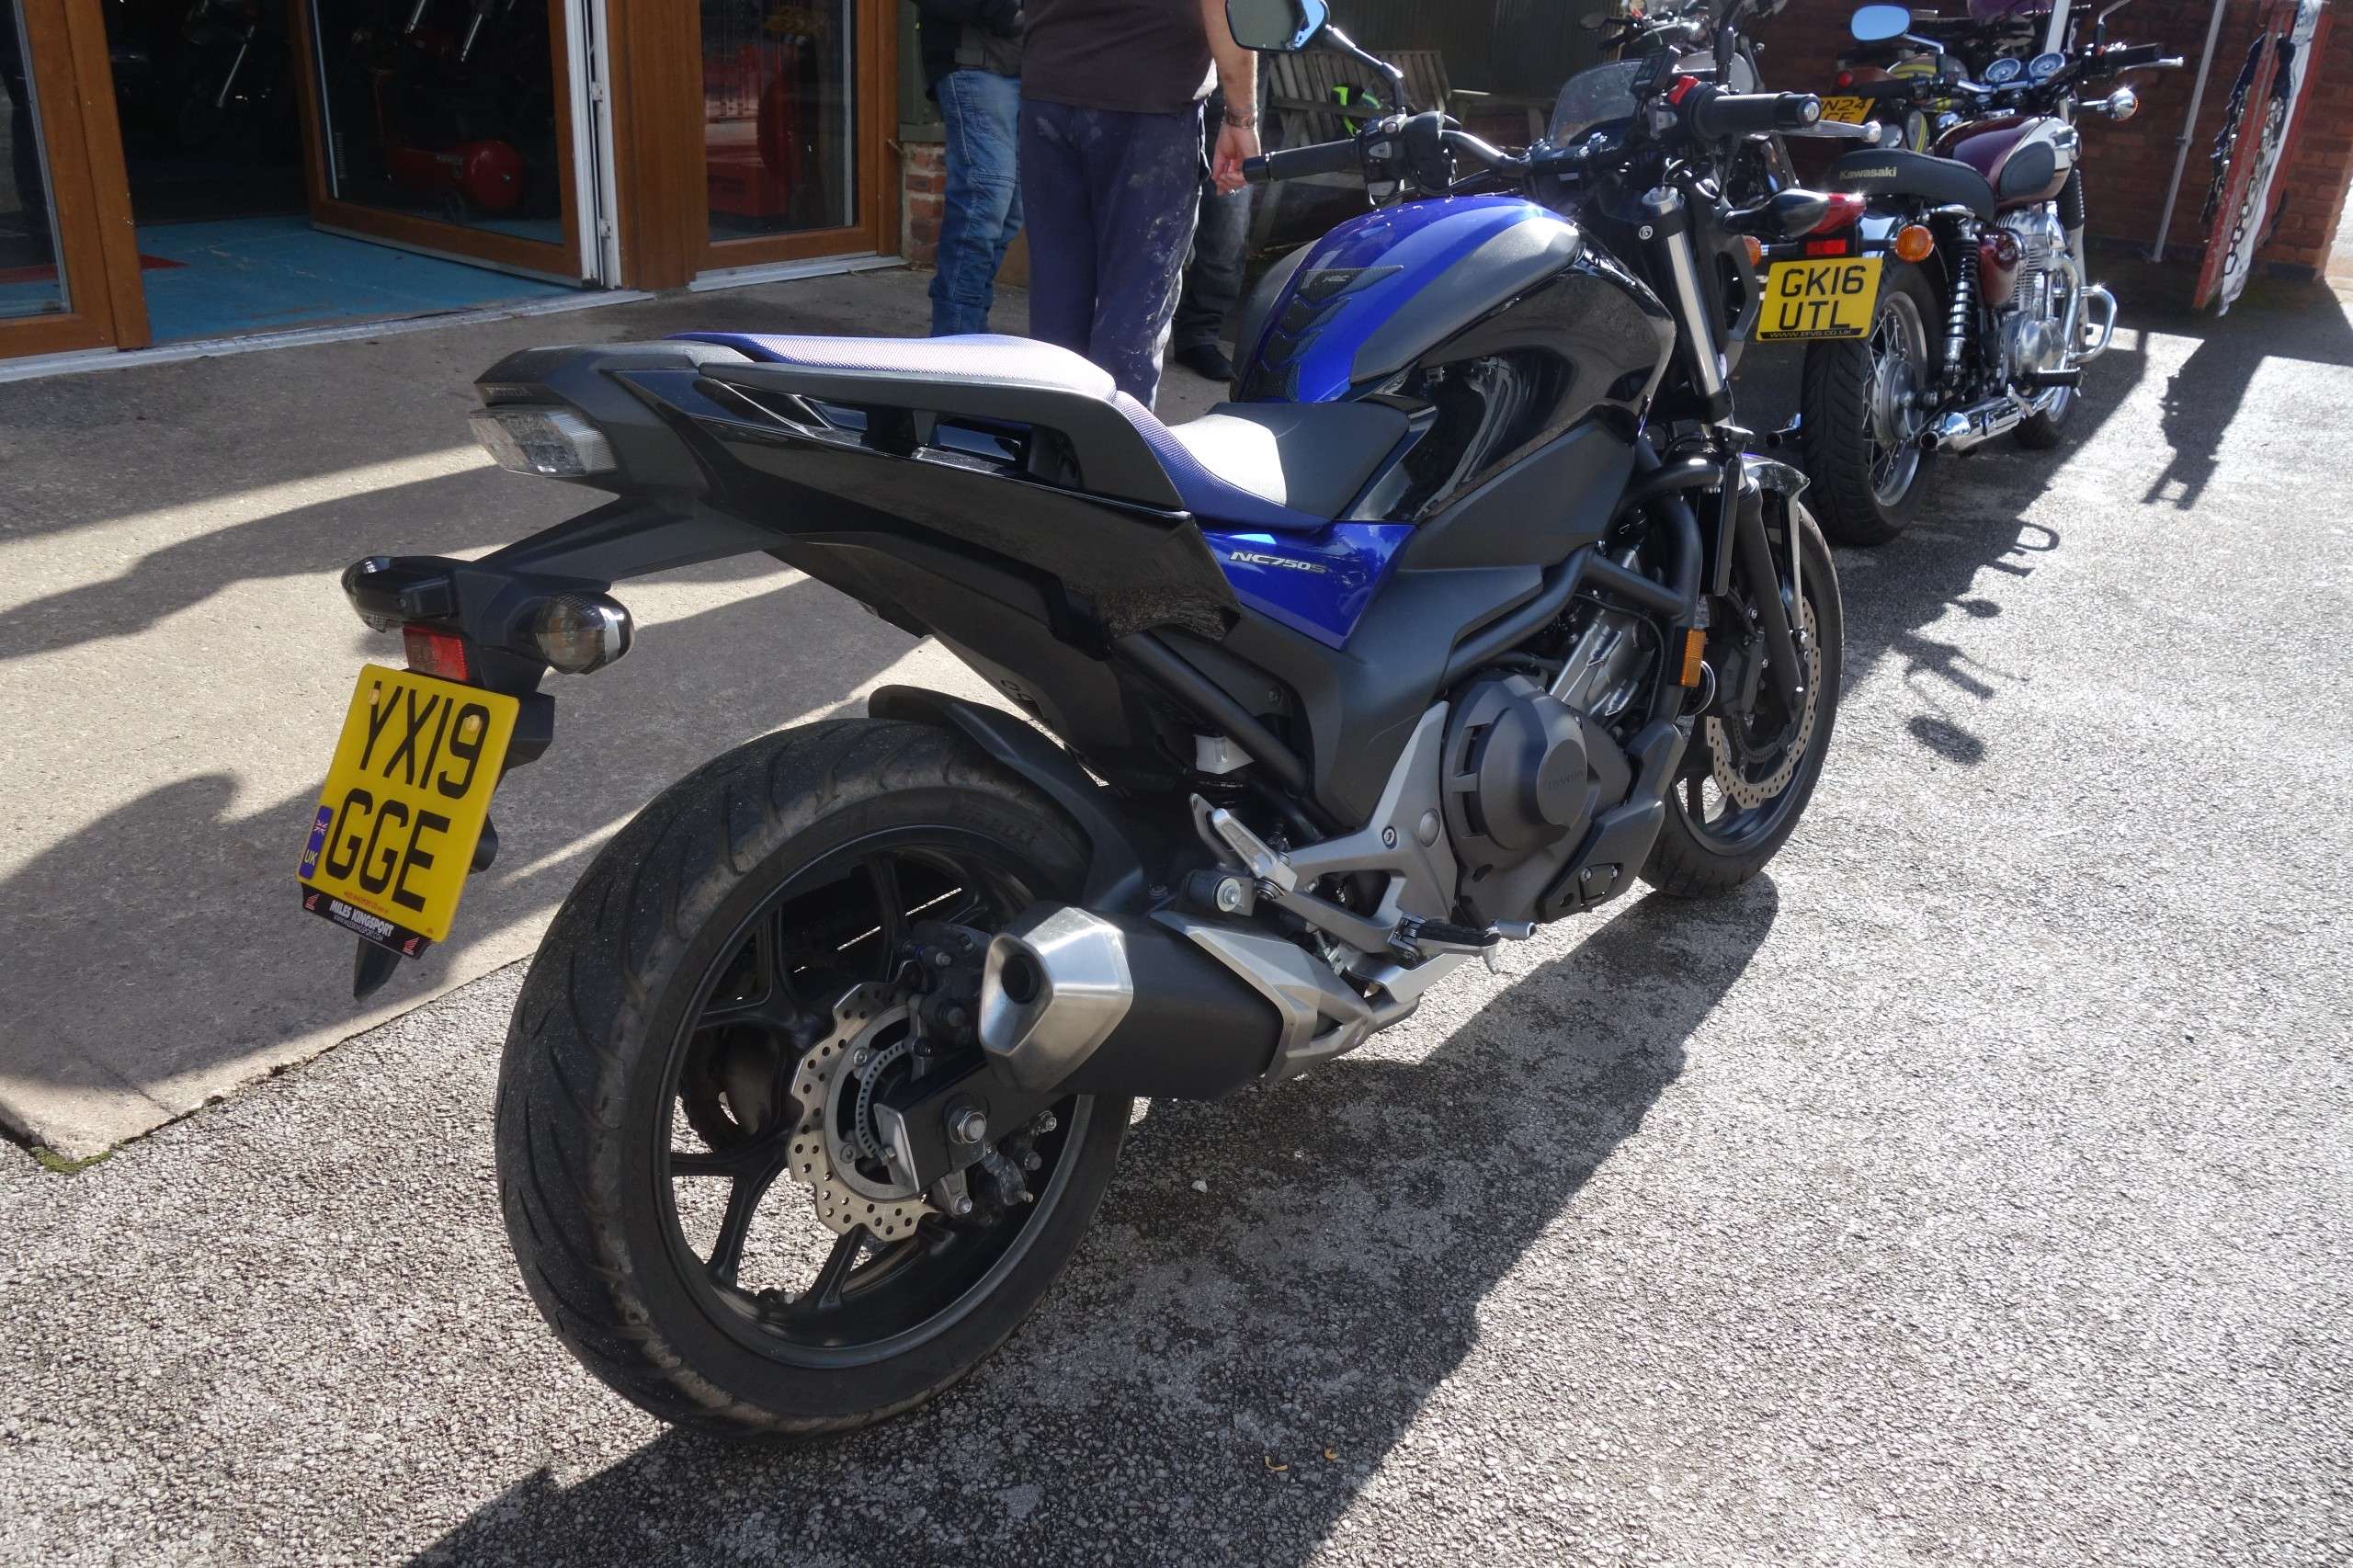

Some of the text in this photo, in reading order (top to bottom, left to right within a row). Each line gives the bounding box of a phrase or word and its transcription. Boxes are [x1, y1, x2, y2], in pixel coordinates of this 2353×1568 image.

[1820, 99, 1867, 111] N24
[1839, 166, 1898, 180] Kawasaki
[1780, 265, 1867, 298] GK16
[1779, 300, 1851, 331] UTL
[1230, 551, 1327, 574] NC750S
[358, 680, 490, 800] YX19
[304, 848, 318, 867] UK
[324, 787, 451, 913] GGE
[329, 900, 352, 918] MILES
[351, 908, 394, 937] KINGSPORT
